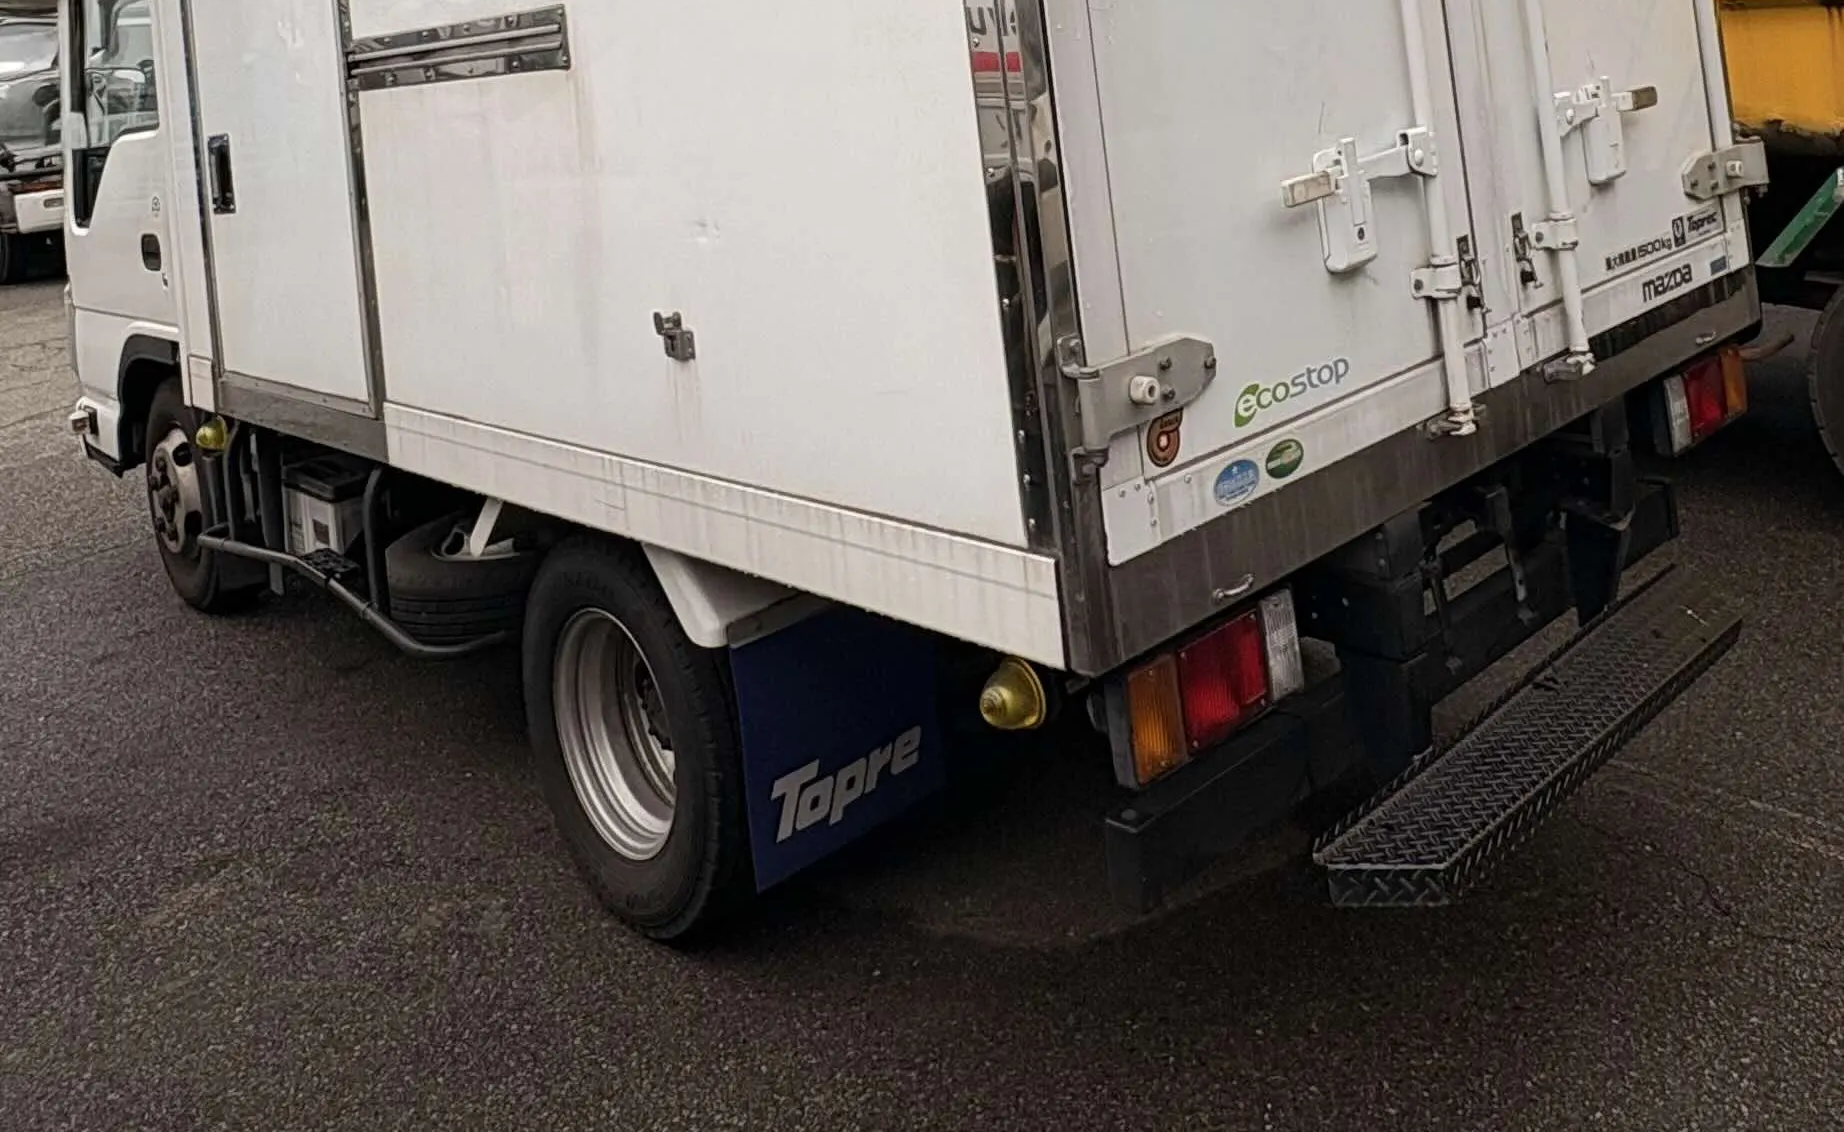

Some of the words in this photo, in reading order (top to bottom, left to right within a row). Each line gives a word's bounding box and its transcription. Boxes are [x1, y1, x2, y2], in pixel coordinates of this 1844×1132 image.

[1642, 263, 1693, 302] mazda
[1234, 358, 1349, 427] ecostop
[770, 725, 922, 844] Topre
